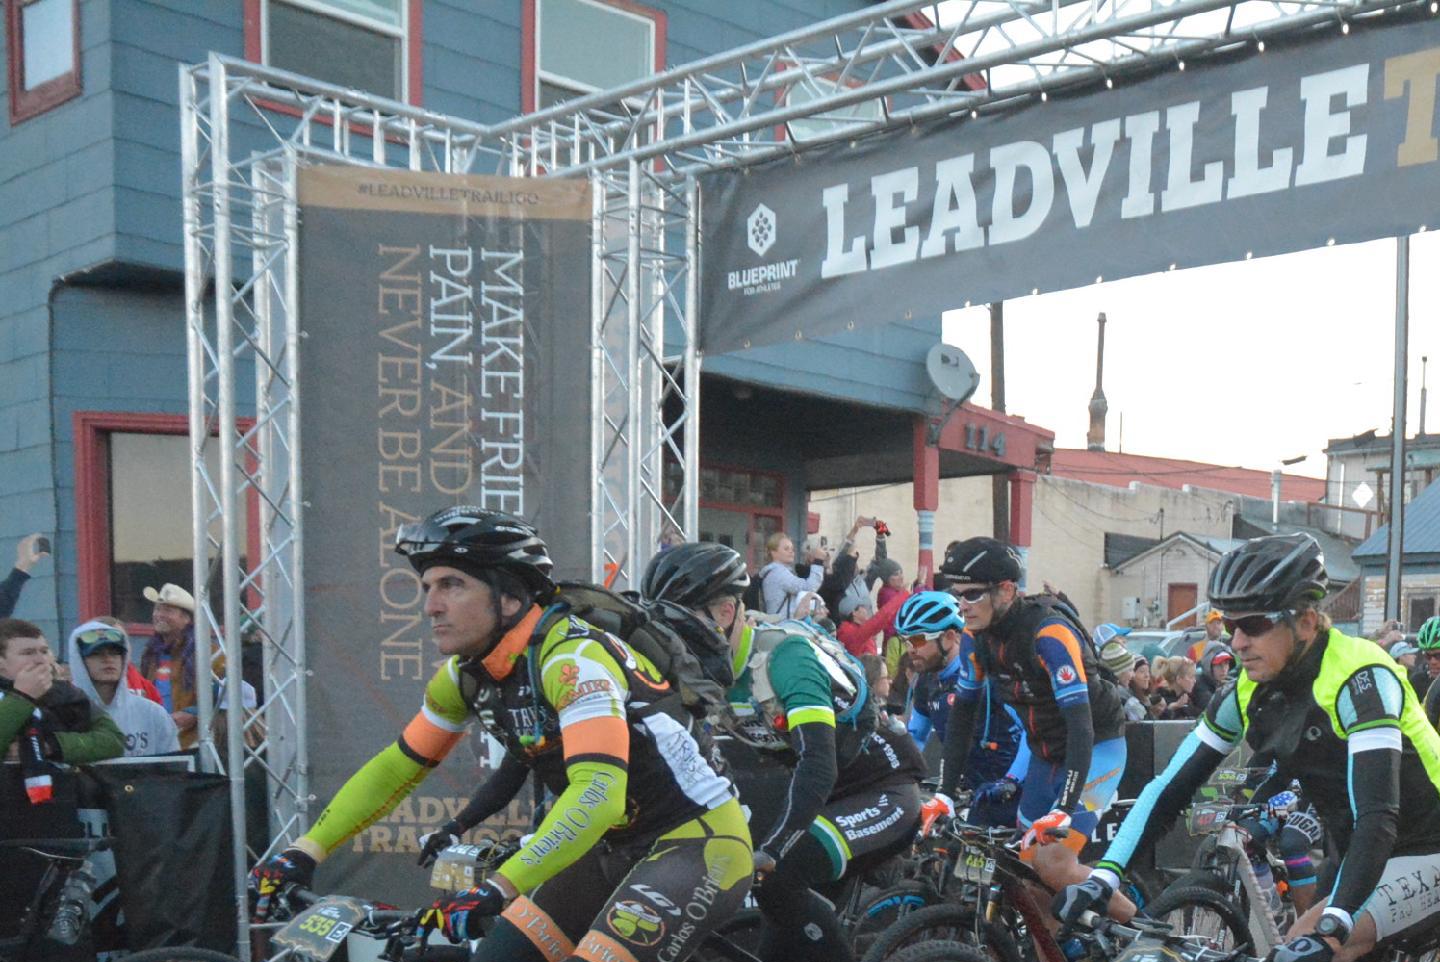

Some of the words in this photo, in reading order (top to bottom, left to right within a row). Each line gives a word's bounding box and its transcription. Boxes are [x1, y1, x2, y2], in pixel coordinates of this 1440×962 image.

[425, 244, 473, 371] PAIN,
[727, 259, 798, 290] BLUEPRINT
[378, 243, 422, 419] NEVER
[480, 247, 525, 399] MAKE
[378, 427, 422, 494] BE
[430, 376, 473, 495] AND
[965, 423, 1006, 456] 114
[835, 806, 882, 828] Sports
[844, 807, 904, 842] Basement
